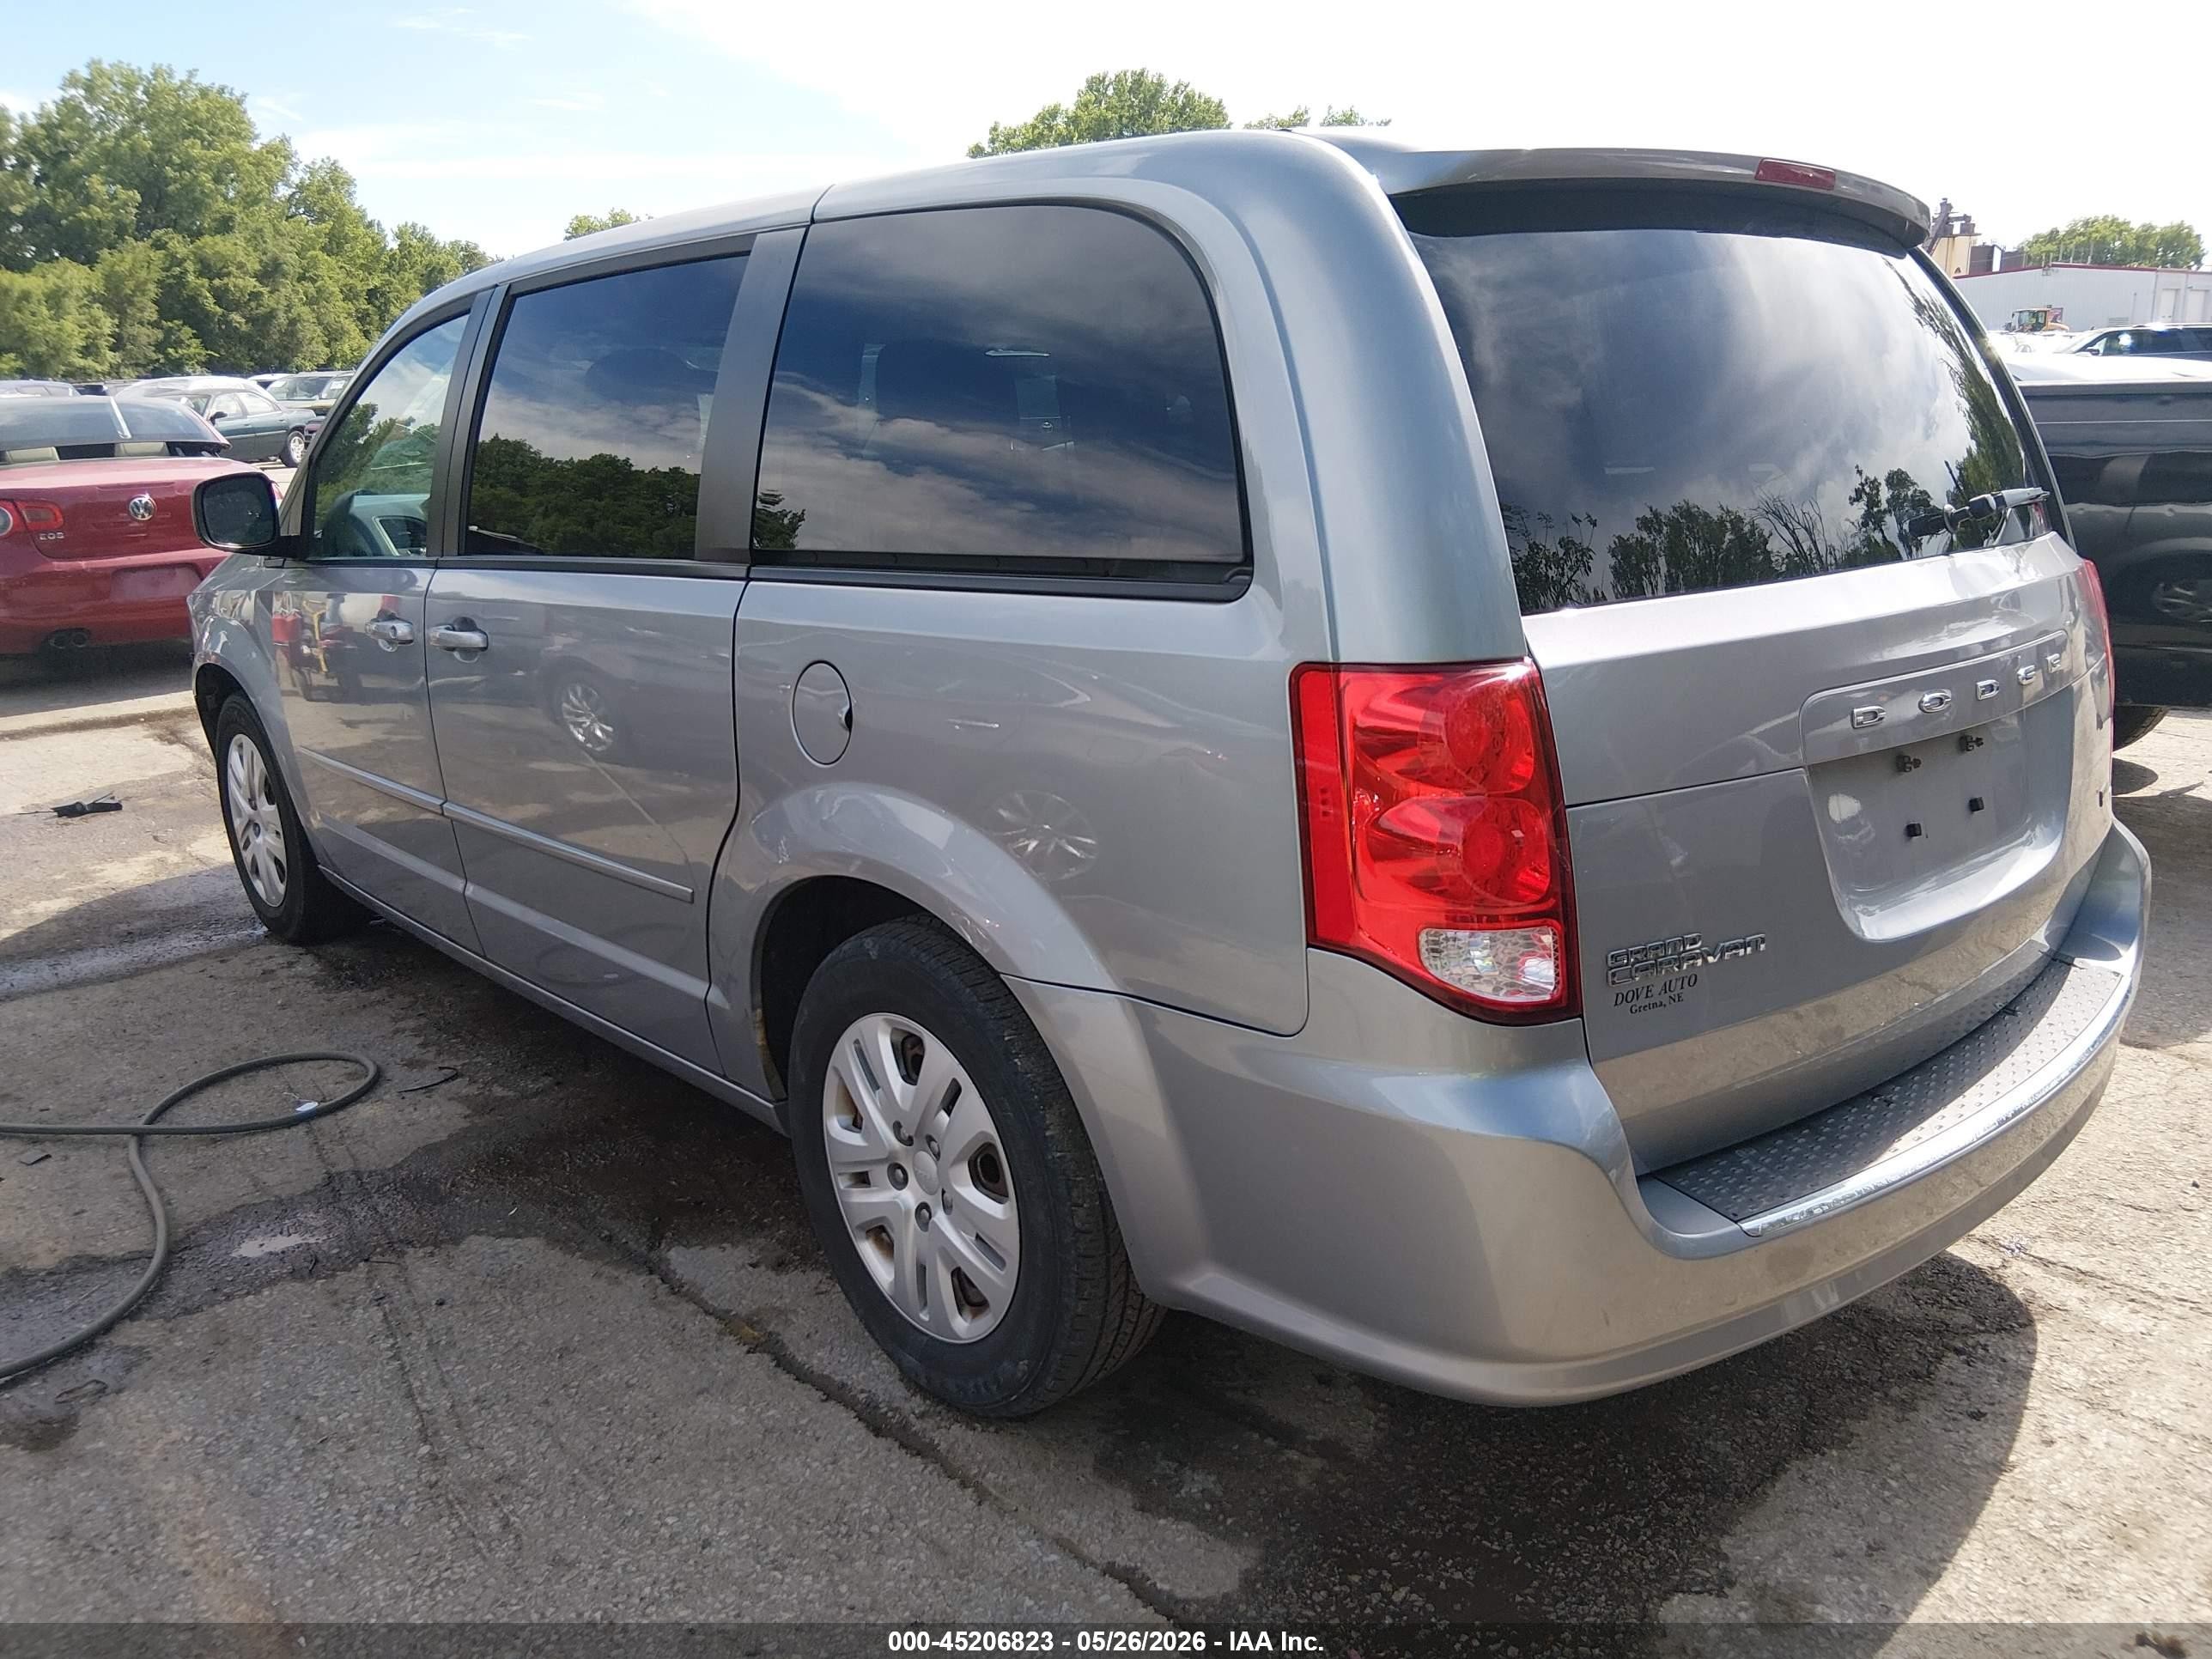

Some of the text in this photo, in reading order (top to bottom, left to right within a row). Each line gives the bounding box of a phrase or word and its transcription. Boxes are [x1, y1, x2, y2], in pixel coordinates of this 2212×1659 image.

[1851, 653, 2061, 728] DODGE
[1607, 933, 1702, 967] GRAND
[1607, 934, 1765, 987] CARAVAN
[1614, 974, 1698, 1006] DOVE AUTO
[1630, 993, 1684, 1014] Gretna, NE
